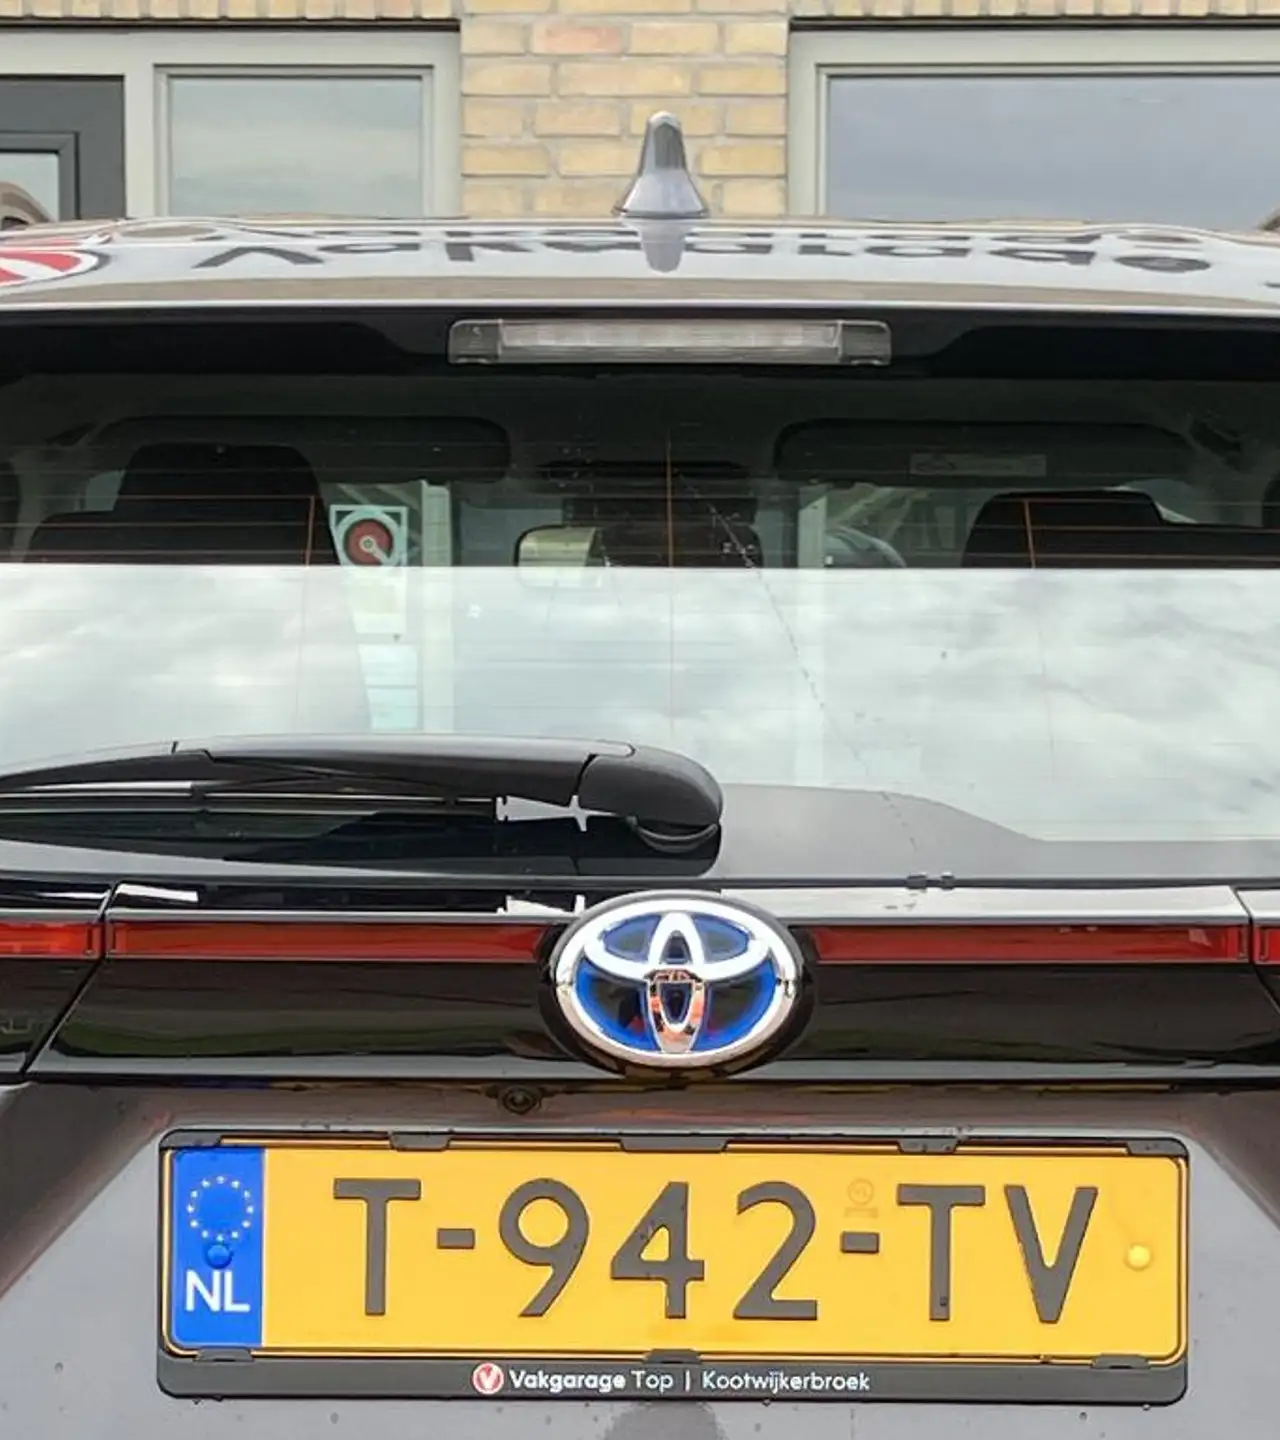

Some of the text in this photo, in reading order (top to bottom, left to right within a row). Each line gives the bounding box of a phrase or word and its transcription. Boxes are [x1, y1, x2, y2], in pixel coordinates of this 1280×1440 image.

[332, 1177, 1099, 1325] T-942-TV
[186, 1270, 251, 1314] NL
[508, 1369, 626, 1394] Vakgarage
[631, 1370, 674, 1392] Top
[702, 1370, 871, 1394] Kootwijkerbroek
